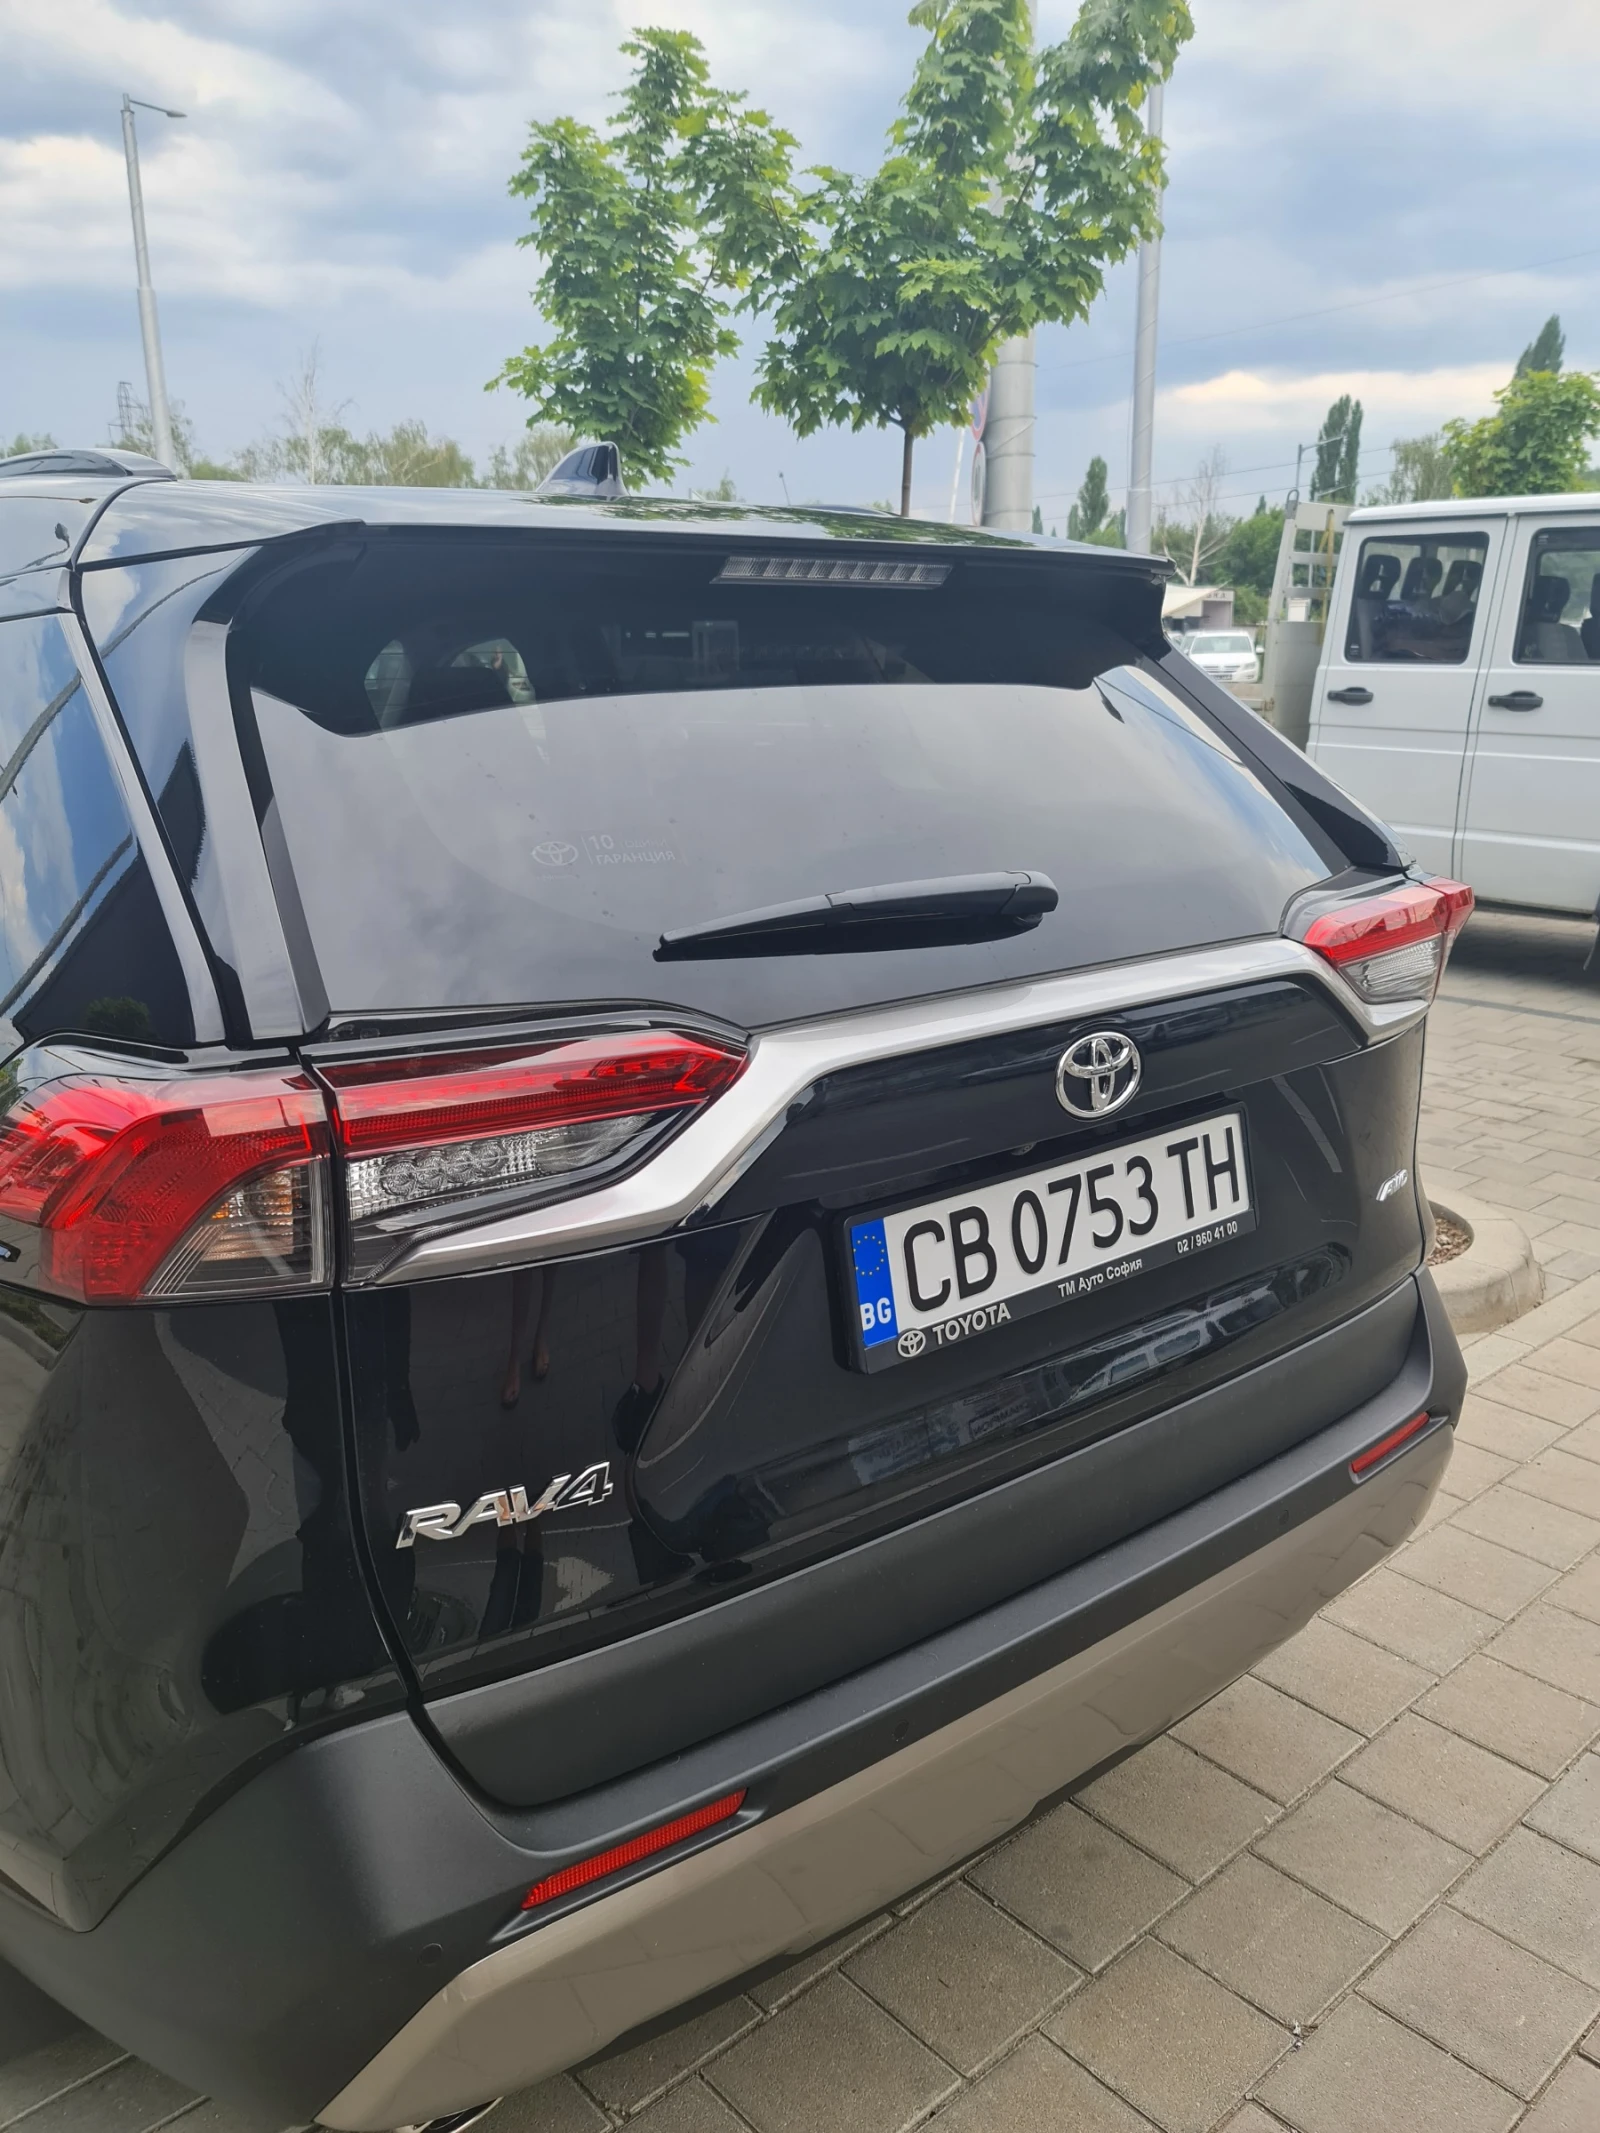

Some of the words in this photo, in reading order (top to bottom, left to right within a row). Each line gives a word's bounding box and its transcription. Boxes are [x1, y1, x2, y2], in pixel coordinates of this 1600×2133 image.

[588, 834, 615, 851] 10
[595, 850, 677, 866] ГАРАНЦИЯ
[903, 1205, 998, 1312] CB
[1011, 1155, 1159, 1275] 0753
[1166, 1126, 1240, 1220] TH
[1176, 1238, 1190, 1254] 02
[1213, 1226, 1226, 1240] 41
[1226, 1220, 1239, 1234] 00
[1078, 1272, 1104, 1291] Ауто
[1105, 1258, 1143, 1281] София
[859, 1296, 893, 1332] BG
[931, 1302, 1012, 1345] TOYOTA
[395, 1460, 614, 1550] RAV4
